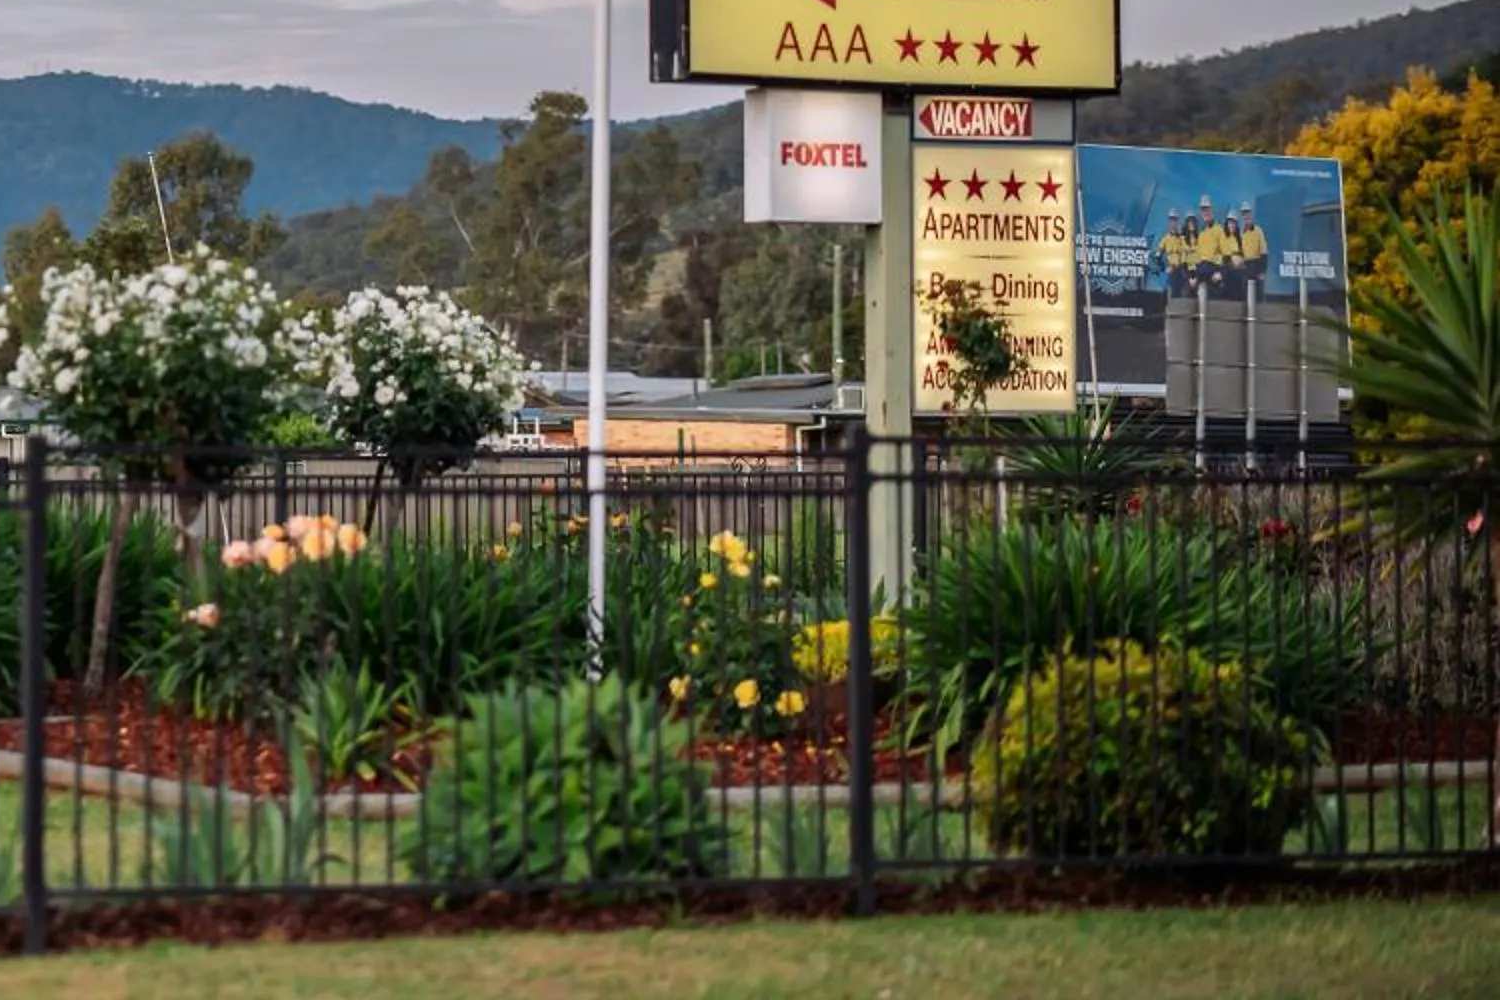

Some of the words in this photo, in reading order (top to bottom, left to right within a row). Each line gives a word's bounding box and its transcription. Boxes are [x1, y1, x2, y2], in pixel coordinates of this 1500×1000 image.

[775, 20, 873, 65] AAA
[929, 100, 1030, 137] VACANCY
[780, 141, 868, 168] FOXTEL
[923, 207, 1066, 243] APARTMENTS
[992, 273, 1059, 305] Dining
